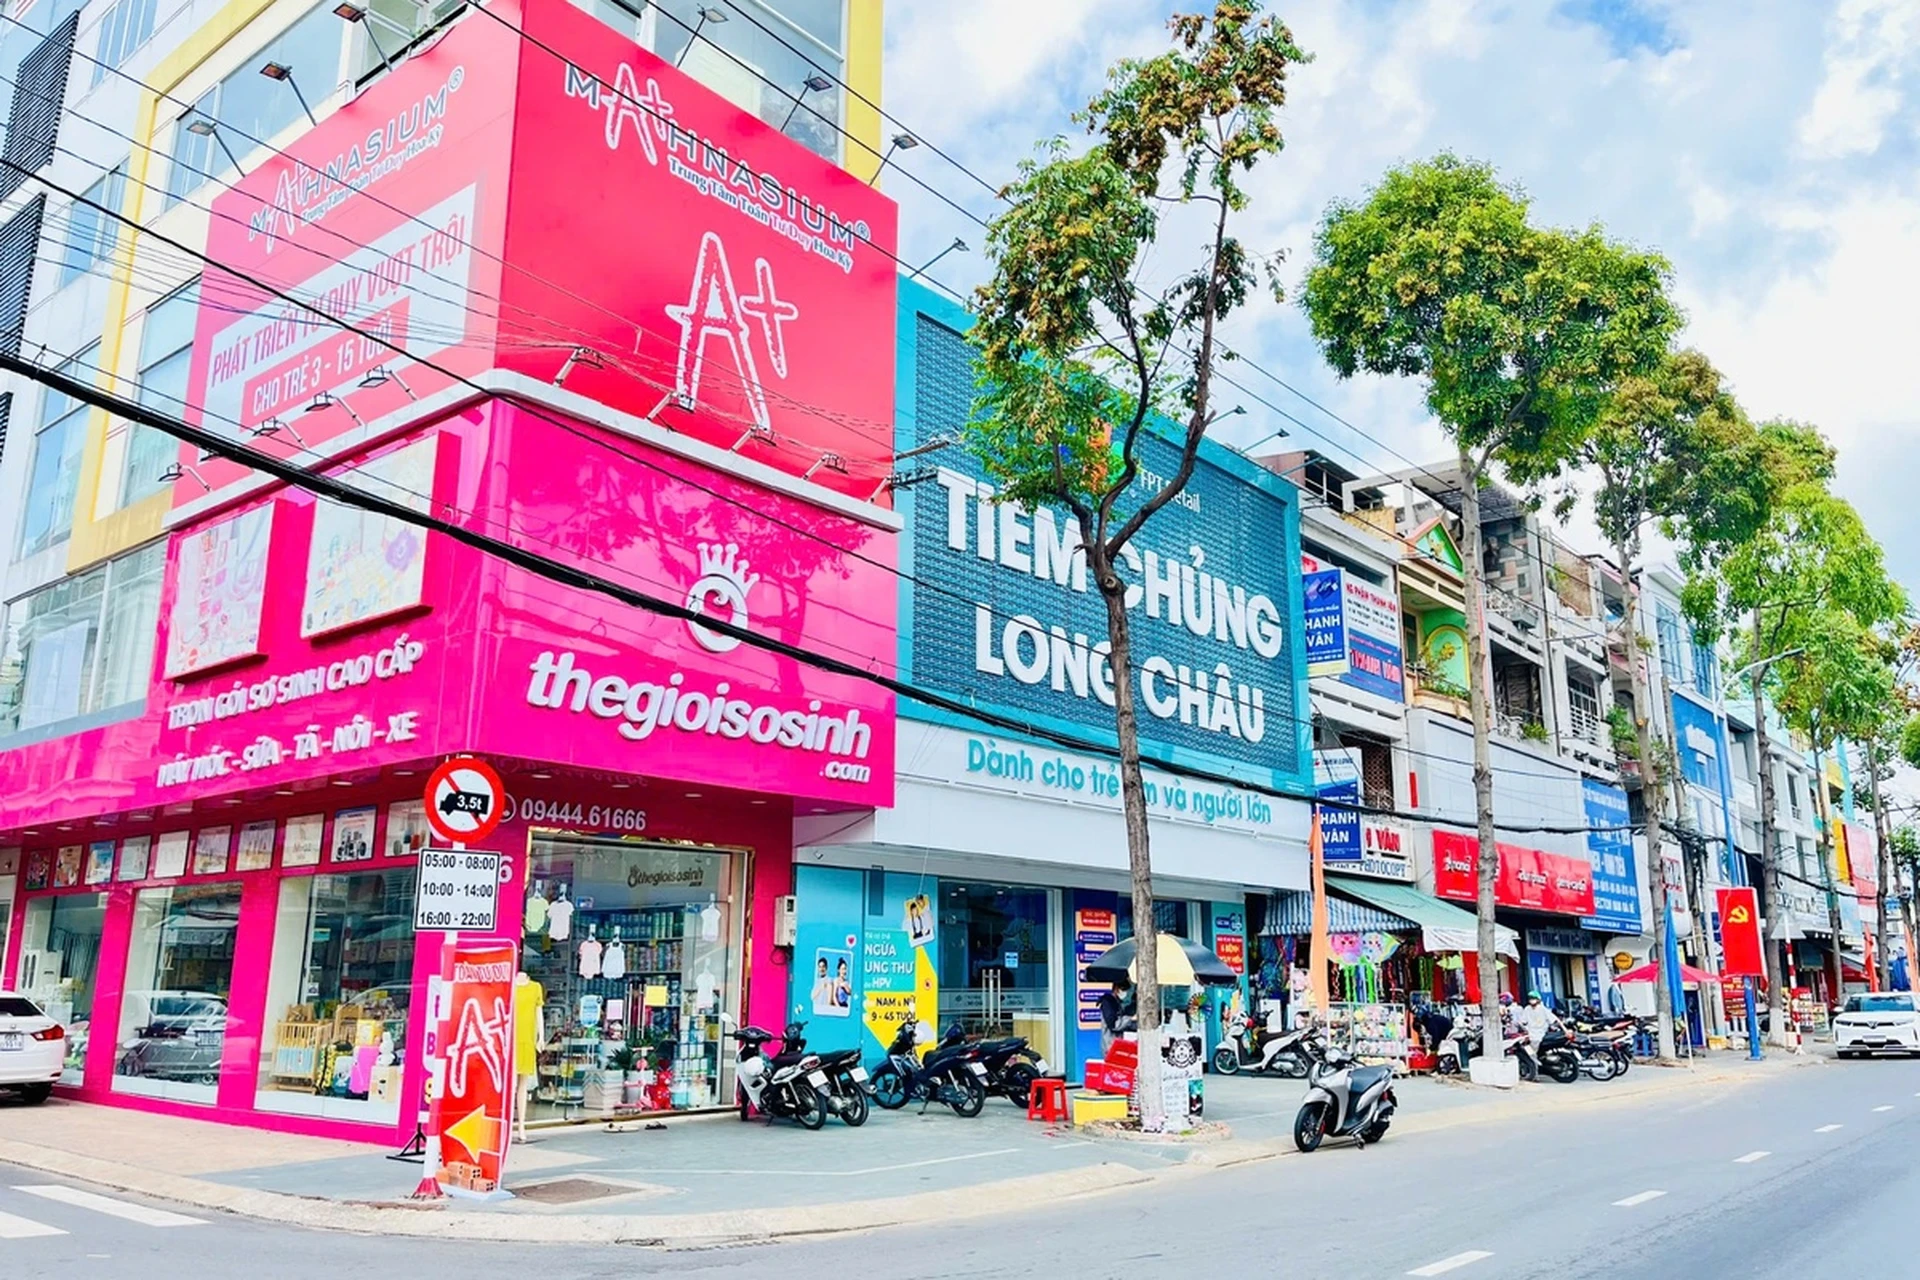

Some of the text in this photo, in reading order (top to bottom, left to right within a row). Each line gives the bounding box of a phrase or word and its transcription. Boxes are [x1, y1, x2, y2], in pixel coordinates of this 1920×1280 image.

[301, 204, 326, 227] Trung
[327, 189, 346, 209] Tâm
[405, 140, 428, 163] Hoa
[669, 157, 707, 193] Trung
[711, 181, 737, 207] Tâm
[740, 197, 769, 224] Toán
[771, 214, 788, 236] Tư
[788, 223, 812, 250] Duy
[813, 237, 837, 261] Hoa
[211, 334, 251, 388] PHÁT
[253, 301, 298, 366] TRIỂN
[326, 273, 363, 320] DUY
[367, 248, 414, 297] VƯỢT
[420, 213, 465, 272] TRỘI
[664, 232, 799, 432] A+
[253, 383, 280, 417] CHO
[283, 353, 308, 395] TRẺ
[311, 357, 322, 387] 3
[336, 338, 355, 375] 15
[1141, 469, 1201, 513] FPT etail
[1305, 614, 1341, 631] HANH
[1306, 631, 1334, 648] VÂN
[214, 681, 249, 720] GÓI
[247, 676, 278, 711] SƠ
[275, 666, 325, 704] SINH
[326, 654, 374, 692] CAO
[374, 632, 424, 680] CẤP
[975, 603, 1265, 743] LONG CHÂU
[527, 651, 871, 759] thegioisosinh
[293, 724, 323, 760] TÃ
[332, 714, 375, 754] NÔI
[385, 711, 420, 744] XE
[818, 760, 871, 783] .com
[967, 738, 1034, 781] Dành
[1041, 757, 1085, 790] cho
[1091, 763, 1120, 797] trẻ
[1164, 775, 1187, 810] và
[1192, 786, 1243, 822] người
[1247, 793, 1272, 824] lớn
[456, 794, 482, 811] 3,5t
[521, 798, 647, 831] 09444.61666
[1320, 812, 1357, 825] HANH
[1323, 828, 1349, 844] VÂN
[424, 853, 456, 868] 05:00
[465, 856, 496, 870] 08:00
[422, 882, 454, 896] 10:00
[463, 884, 494, 897] 14:00
[420, 911, 451, 925] 16:00
[461, 912, 491, 926] 22:00
[865, 961, 914, 974] UNG THƯ
[872, 977, 892, 989] HPV
[876, 998, 896, 1007] NAM
[871, 1011, 877, 1021] 9
[884, 1011, 895, 1021] 45
